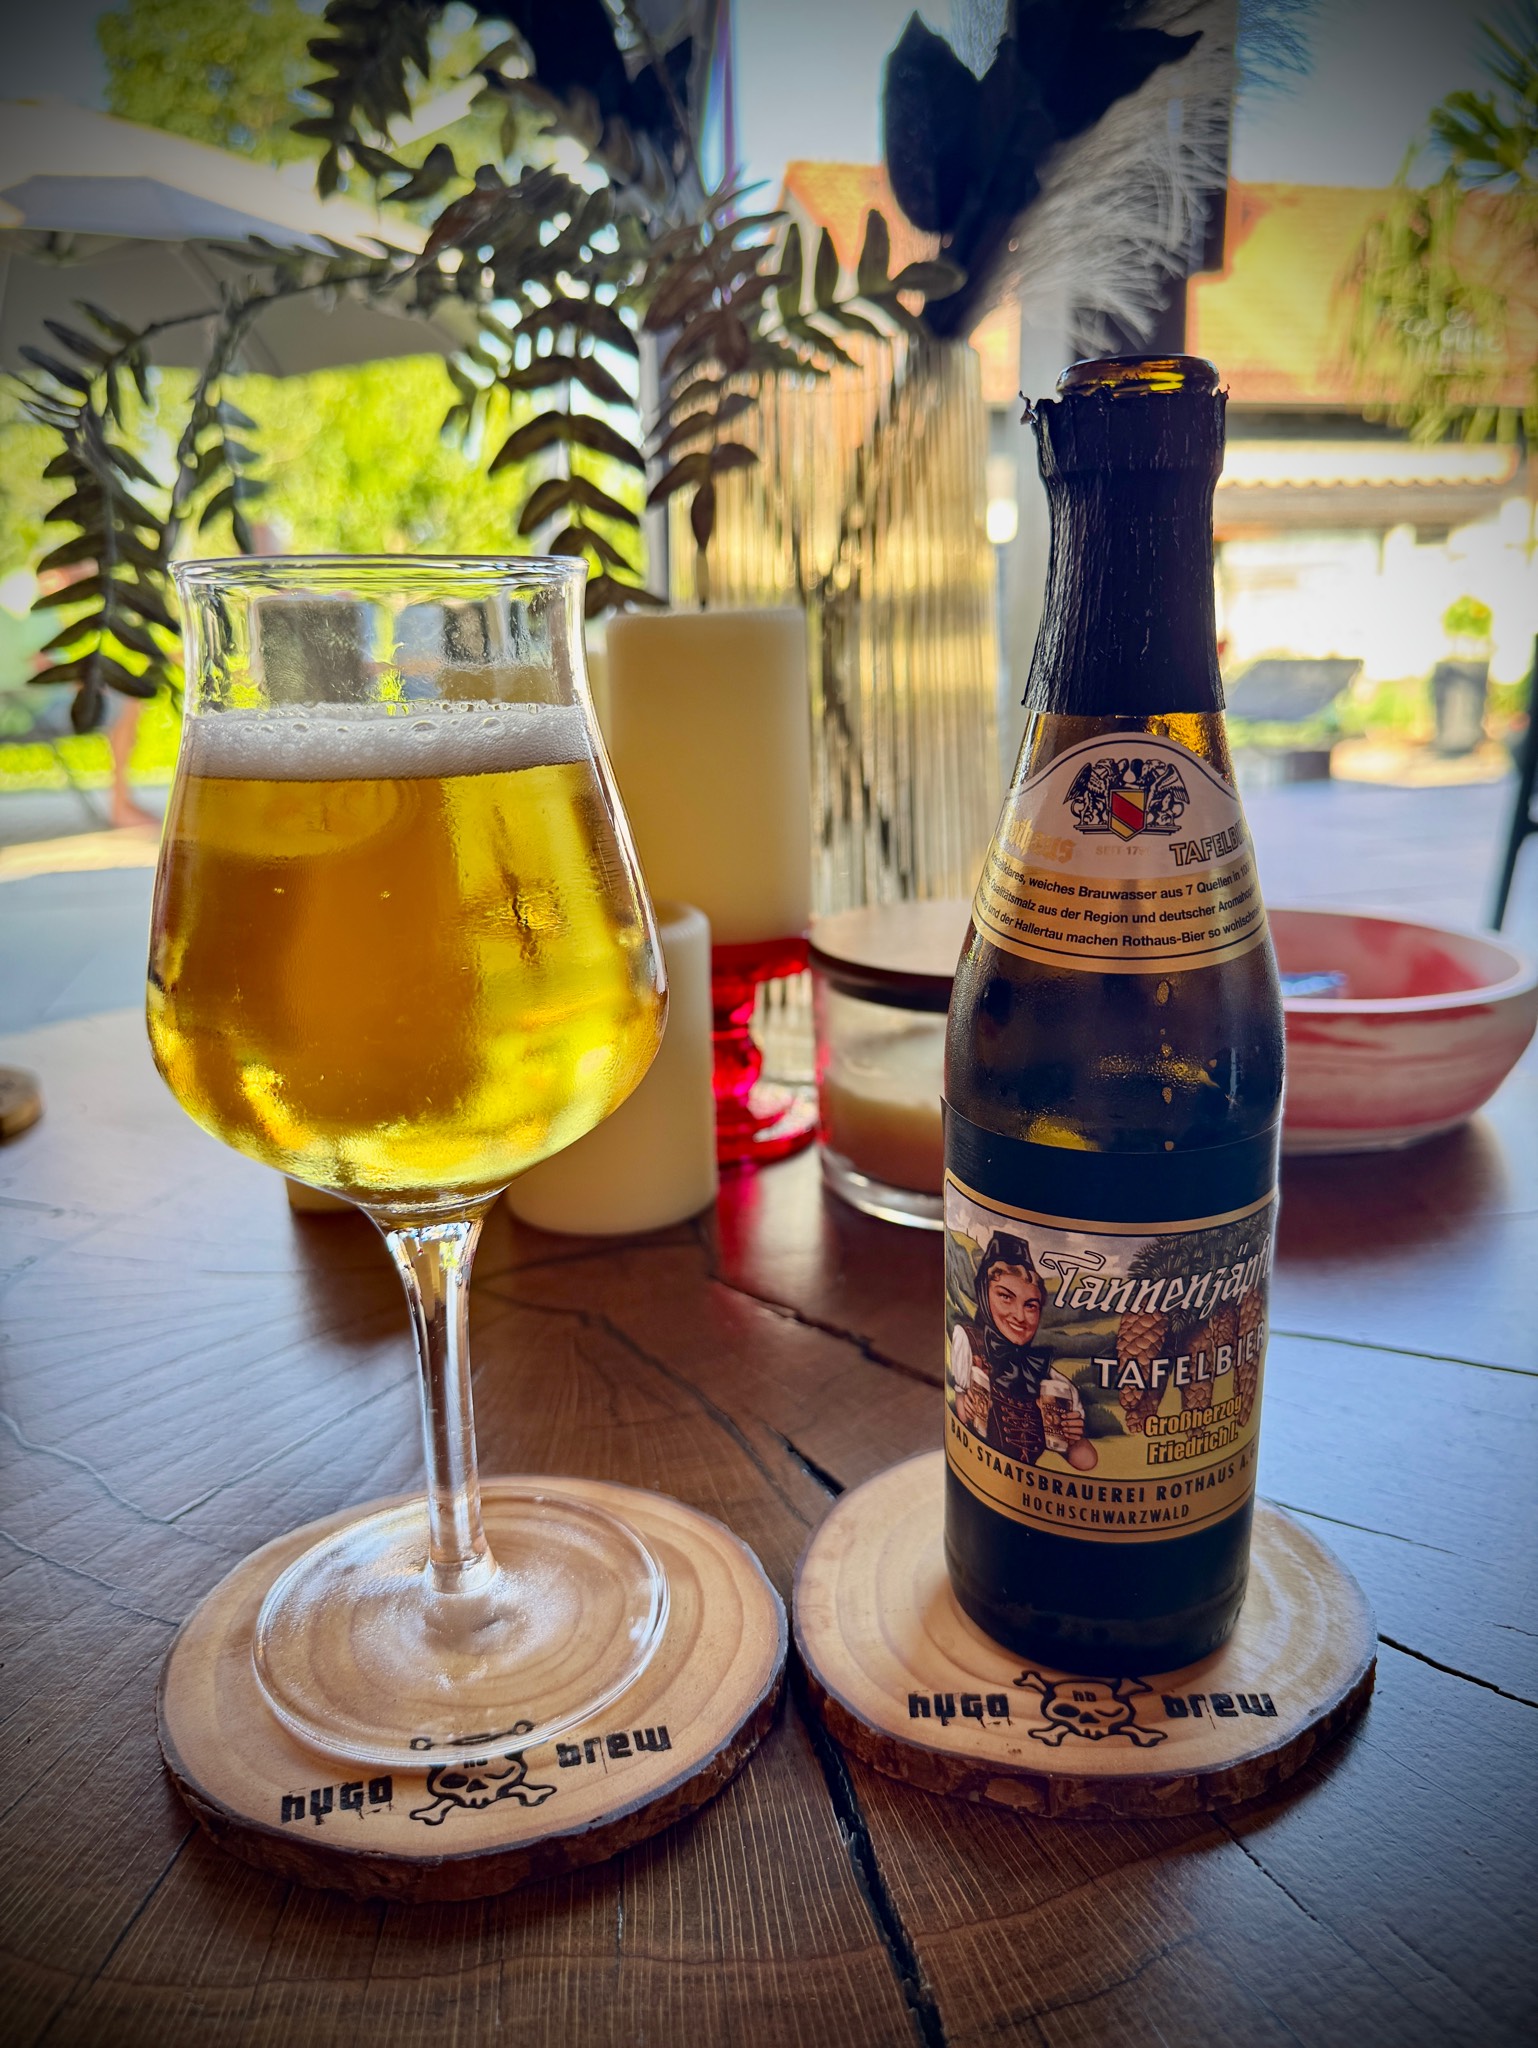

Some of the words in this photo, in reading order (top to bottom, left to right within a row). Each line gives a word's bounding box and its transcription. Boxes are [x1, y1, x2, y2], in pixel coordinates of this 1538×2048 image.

[990, 878, 1036, 911] Qualitätsmalz
[1038, 904, 1057, 916] aus
[1061, 907, 1081, 919] der
[1084, 910, 1128, 925] Region
[1132, 912, 1155, 923] und
[1160, 906, 1216, 922] deutscher
[1029, 877, 1075, 895] weiches
[1078, 886, 1157, 900] Brauwasser
[1160, 888, 1183, 899] aus
[1186, 884, 1193, 895] 7
[1197, 876, 1233, 893] Quellen
[1233, 870, 1240, 882] in
[988, 903, 1000, 918] und
[1000, 913, 1014, 925] der
[1015, 918, 1063, 940] Hallertau
[1066, 933, 1118, 946] machen
[1122, 931, 1205, 947] Rothaus-Bier
[1208, 928, 1221, 938] so
[1144, 1392, 1243, 1438] Großherzog
[950, 1417, 973, 1454] BAD.
[977, 1445, 1145, 1503] STAATSBRAUEREI
[1156, 1463, 1235, 1500] ROTHAUS
[1147, 1424, 1229, 1465] Friedrich
[1022, 1493, 1190, 1526] HOCHSCHWARZWALD
